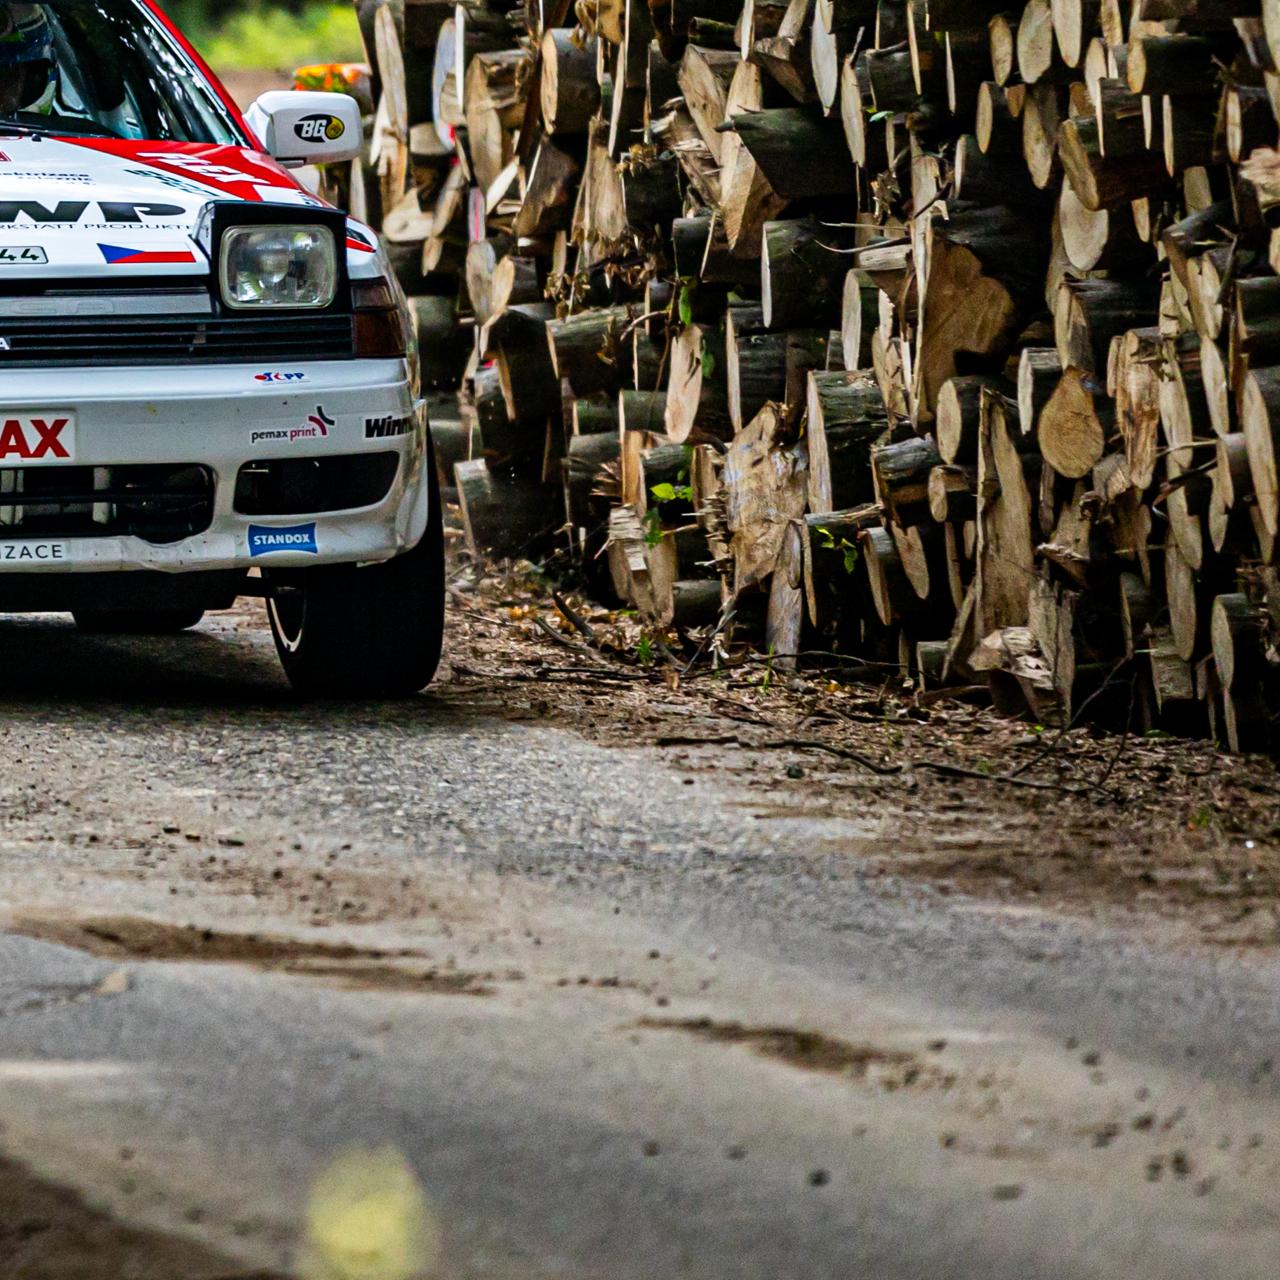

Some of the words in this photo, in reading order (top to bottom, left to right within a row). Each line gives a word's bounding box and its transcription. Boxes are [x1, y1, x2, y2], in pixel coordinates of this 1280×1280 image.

[251, 429, 288, 444] pemax
[289, 425, 317, 441] print
[253, 533, 310, 546] STANDOX
